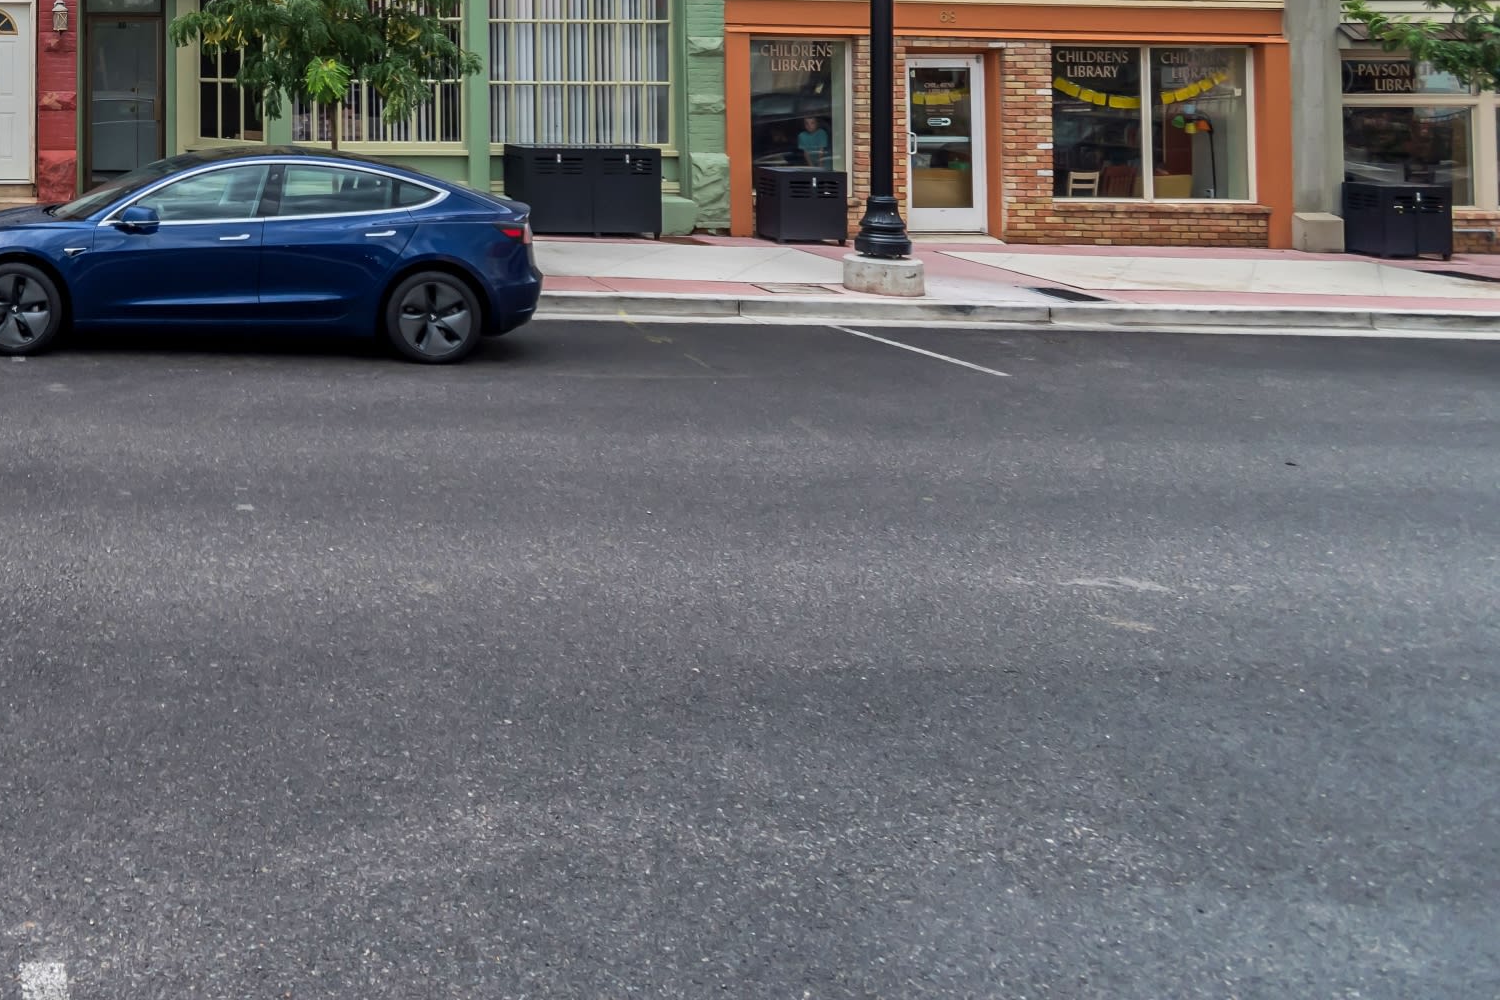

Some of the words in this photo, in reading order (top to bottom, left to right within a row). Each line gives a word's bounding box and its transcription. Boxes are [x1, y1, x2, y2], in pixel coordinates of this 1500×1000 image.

[771, 59, 824, 72] LIBRARY
[1067, 65, 1119, 78] LIBRARY
[1357, 63, 1410, 77] PAYSON
